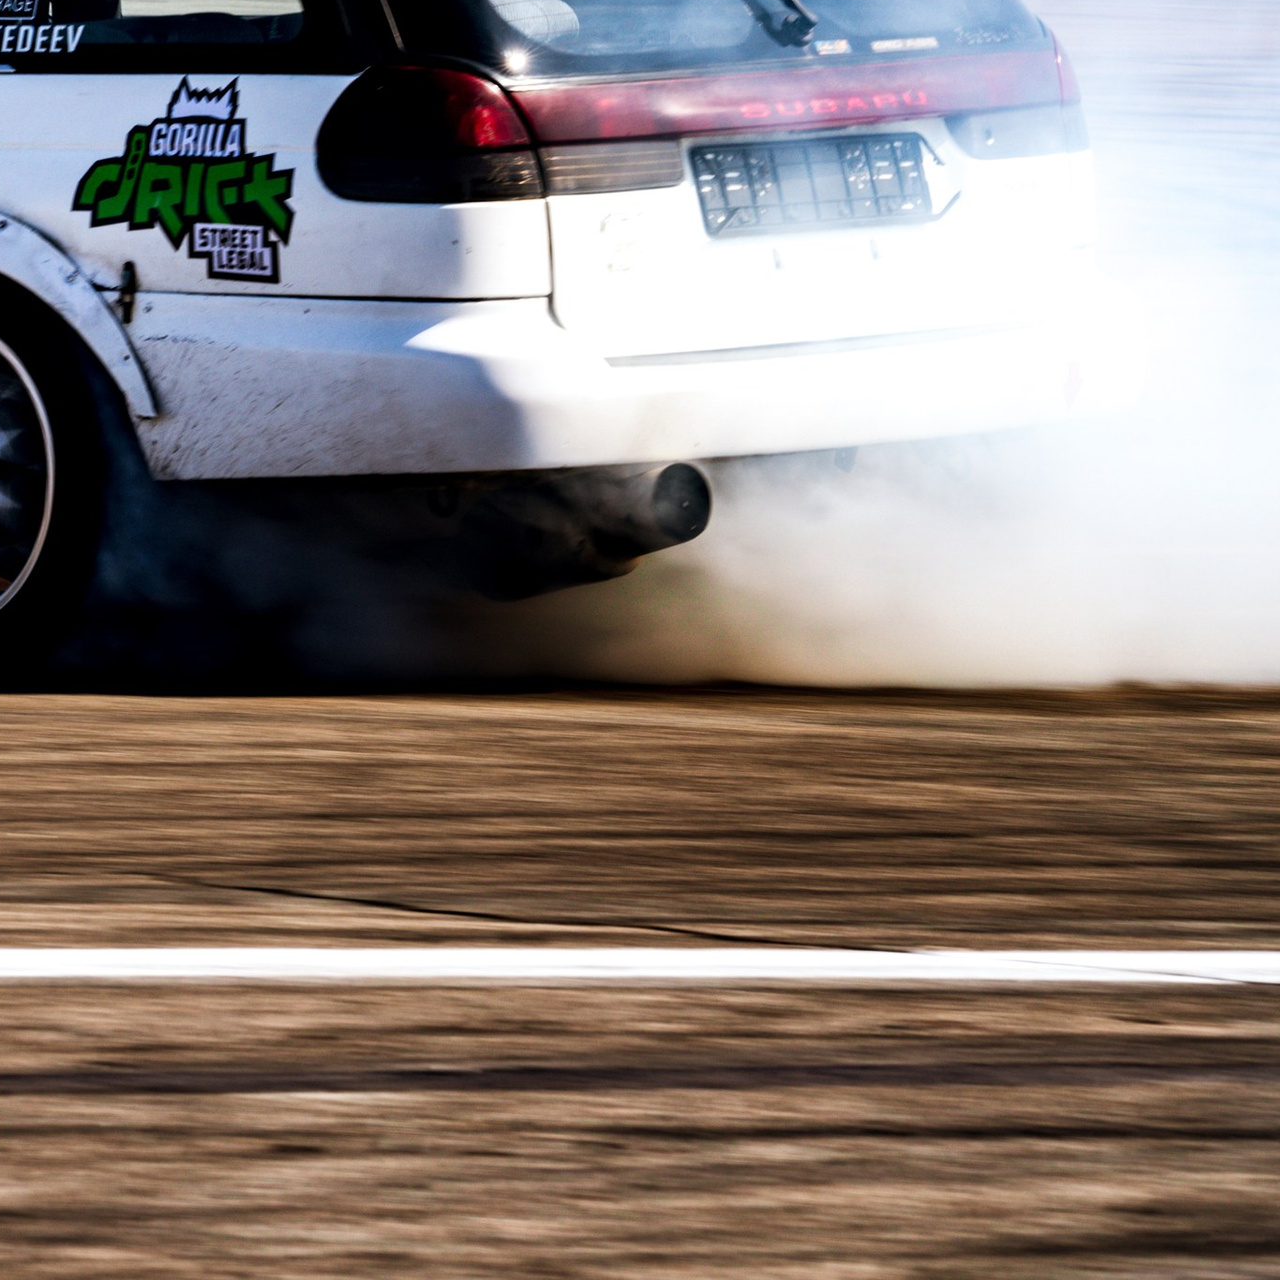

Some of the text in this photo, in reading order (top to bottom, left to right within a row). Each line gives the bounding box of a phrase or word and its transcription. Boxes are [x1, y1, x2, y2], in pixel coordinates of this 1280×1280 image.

[739, 88, 929, 119] SUBARU
[148, 122, 242, 158] GORILLA
[197, 226, 260, 250] STREET
[215, 249, 270, 272] LEGAL
